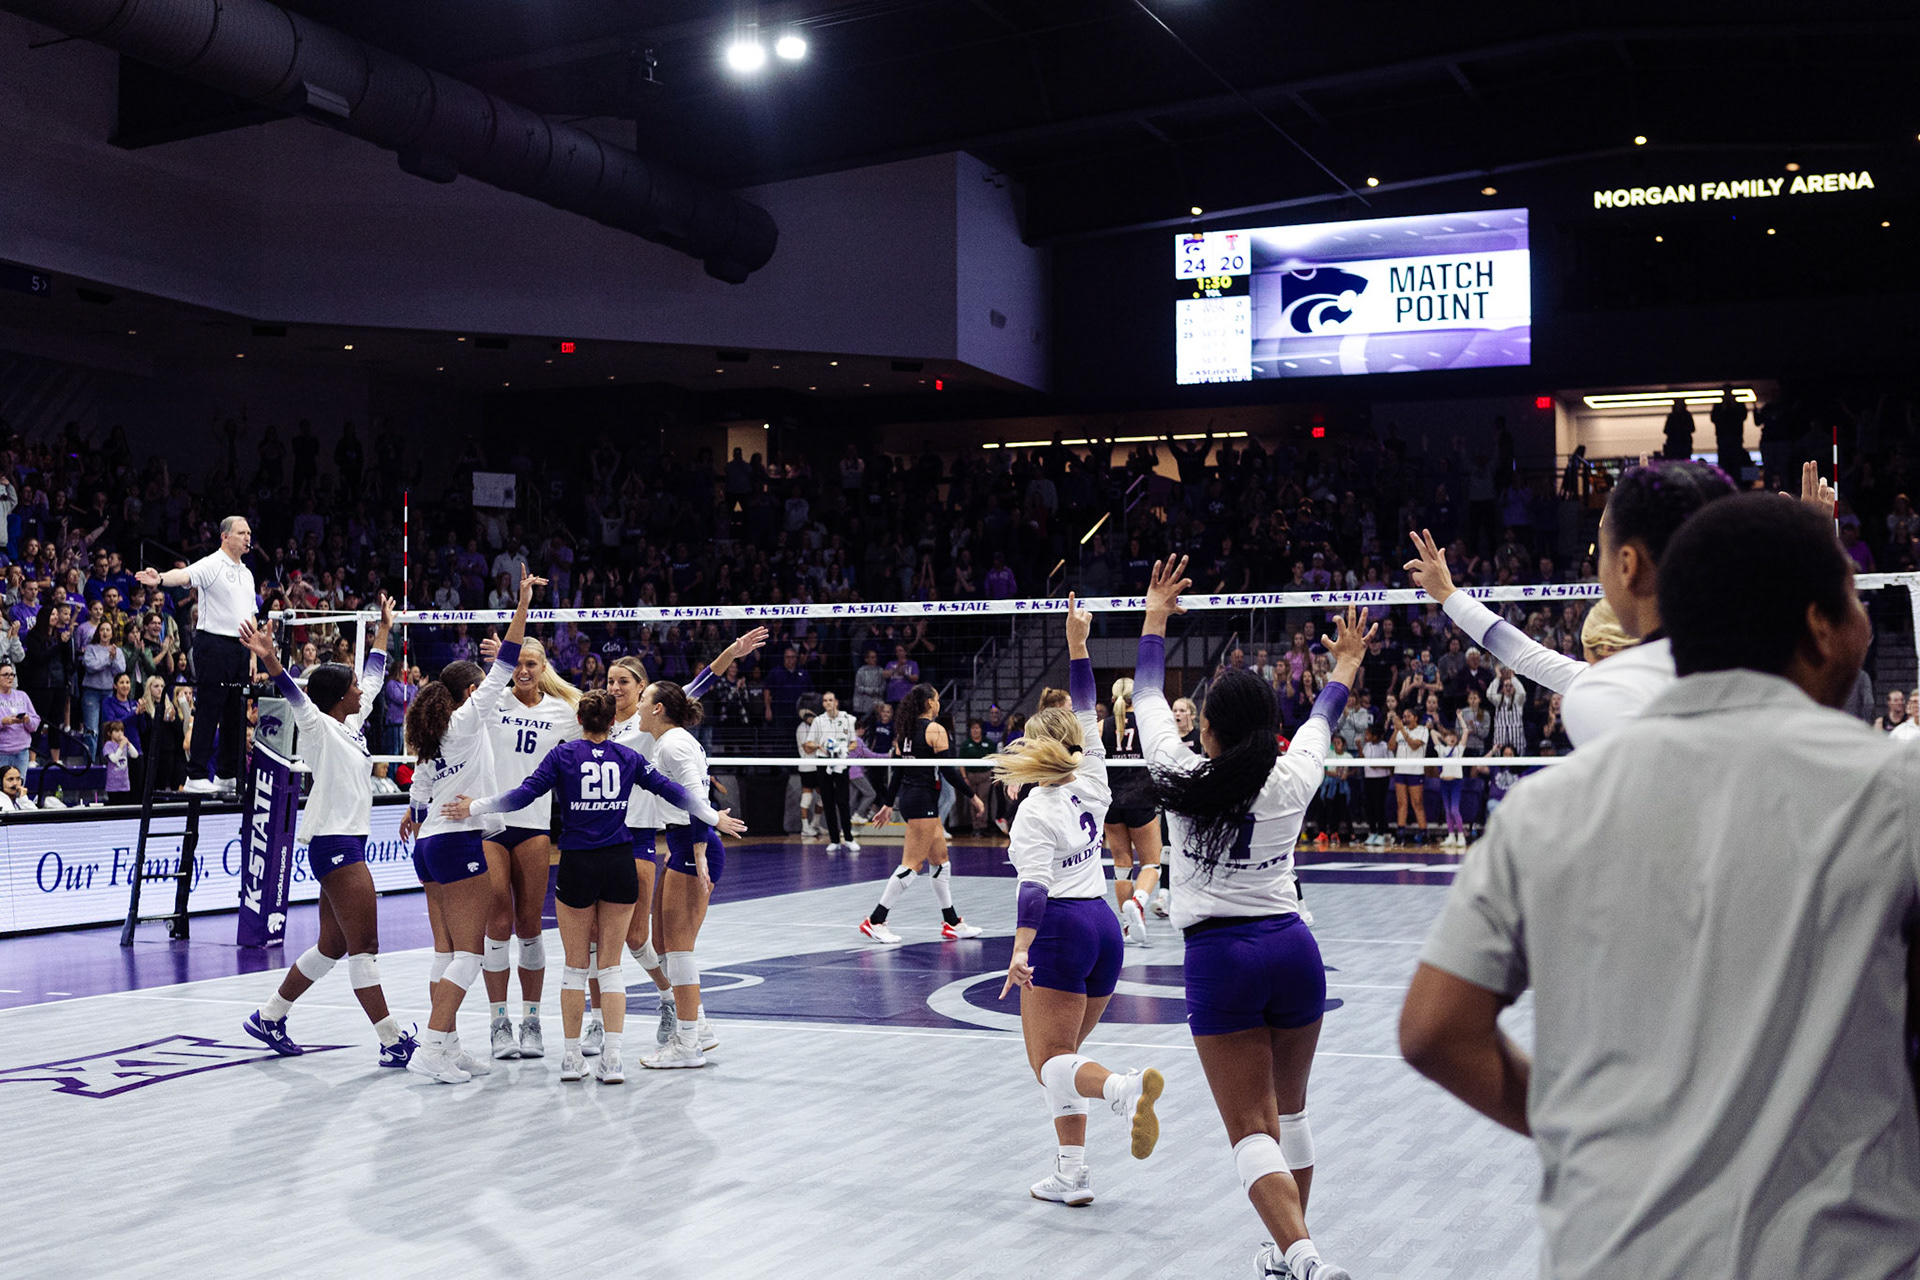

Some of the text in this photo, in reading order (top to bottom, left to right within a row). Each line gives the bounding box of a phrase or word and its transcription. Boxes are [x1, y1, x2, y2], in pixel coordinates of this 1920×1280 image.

[1594, 171, 1874, 209] MORGAN FAMILY ARENA
[1183, 256, 1244, 274] 24 20
[1196, 275, 1232, 290] 1:30
[1390, 260, 1494, 294] MATCH
[32, 276, 40, 291] 5
[1396, 292, 1490, 324] POINT
[1328, 591, 1387, 602] K-STATE
[1541, 586, 1604, 596] K-STATE
[1032, 600, 1085, 610] K-STAE
[1226, 594, 1283, 605] K-STATE
[592, 608, 638, 618] K-STATE
[674, 607, 722, 618] K-STATE
[760, 606, 810, 616] K-STATE
[848, 604, 898, 614] K-STATE
[938, 602, 991, 612] K-STATE
[432, 611, 477, 620] K-STATE
[511, 610, 556, 620] TATE
[502, 716, 553, 730] K-STATE
[515, 728, 538, 754] 16
[1115, 728, 1134, 752] 17
[580, 762, 620, 800] 20
[570, 801, 628, 811] WILDCATS
[244, 768, 274, 914] K-STATE
[36, 852, 98, 892] Our
[108, 846, 209, 893] Famiy.
[366, 839, 413, 864] ours.
